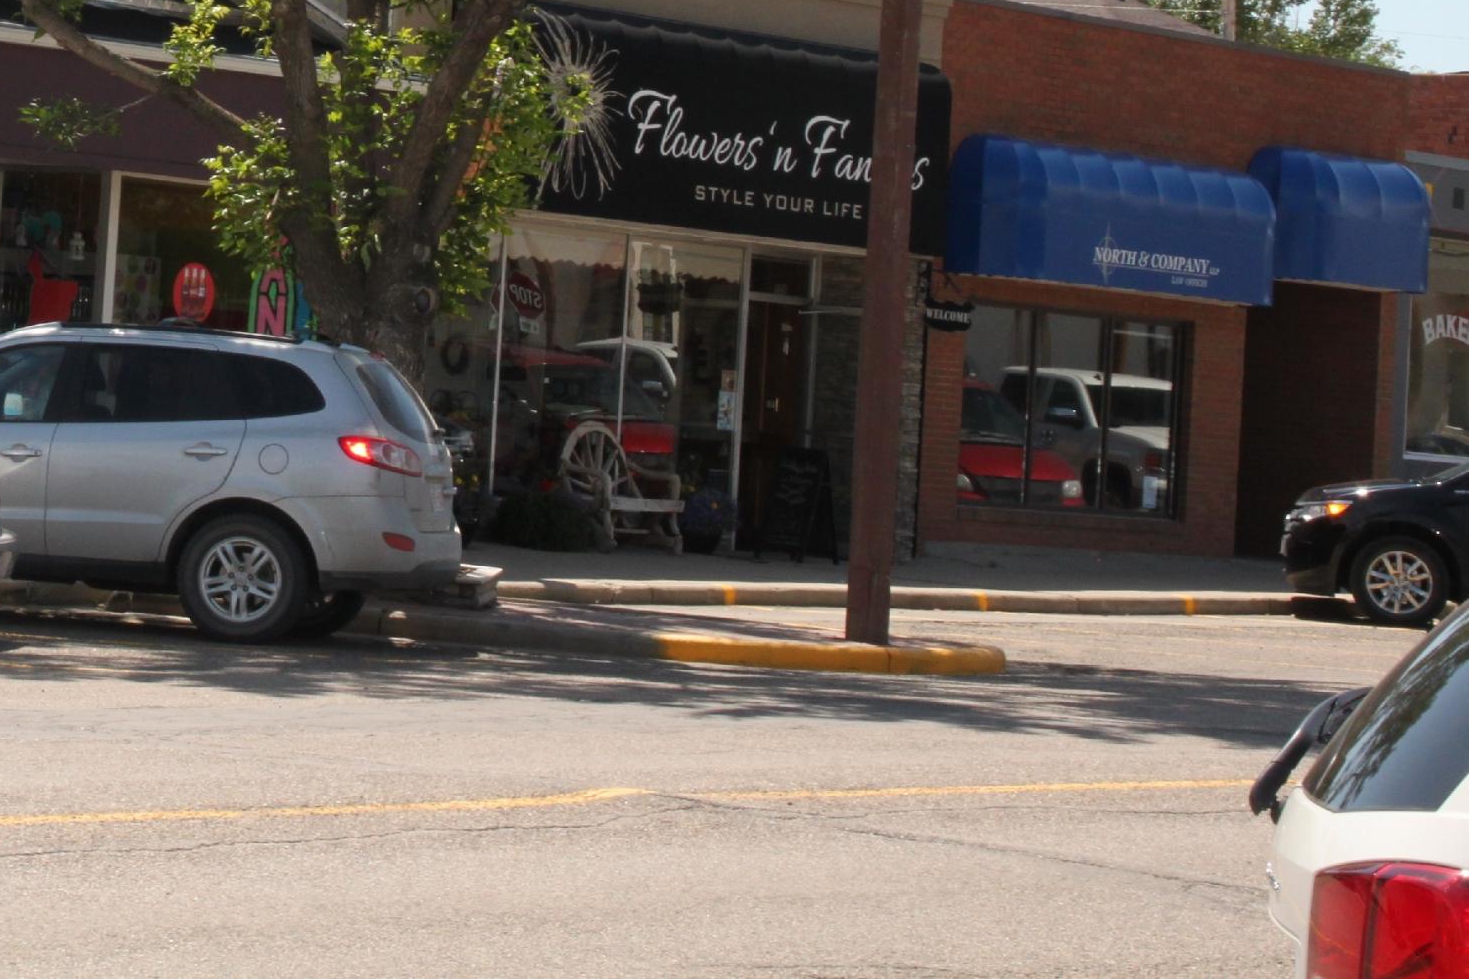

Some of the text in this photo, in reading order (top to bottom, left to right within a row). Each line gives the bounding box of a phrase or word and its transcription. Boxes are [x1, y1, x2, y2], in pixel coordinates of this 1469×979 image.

[628, 89, 764, 171] Flowers
[694, 185, 863, 220] STYLE YOUR LIFE
[1093, 246, 1138, 266] NORTH
[1138, 251, 1150, 267] &
[1151, 253, 1210, 274] COMPANY
[926, 308, 971, 324] WELCOME
